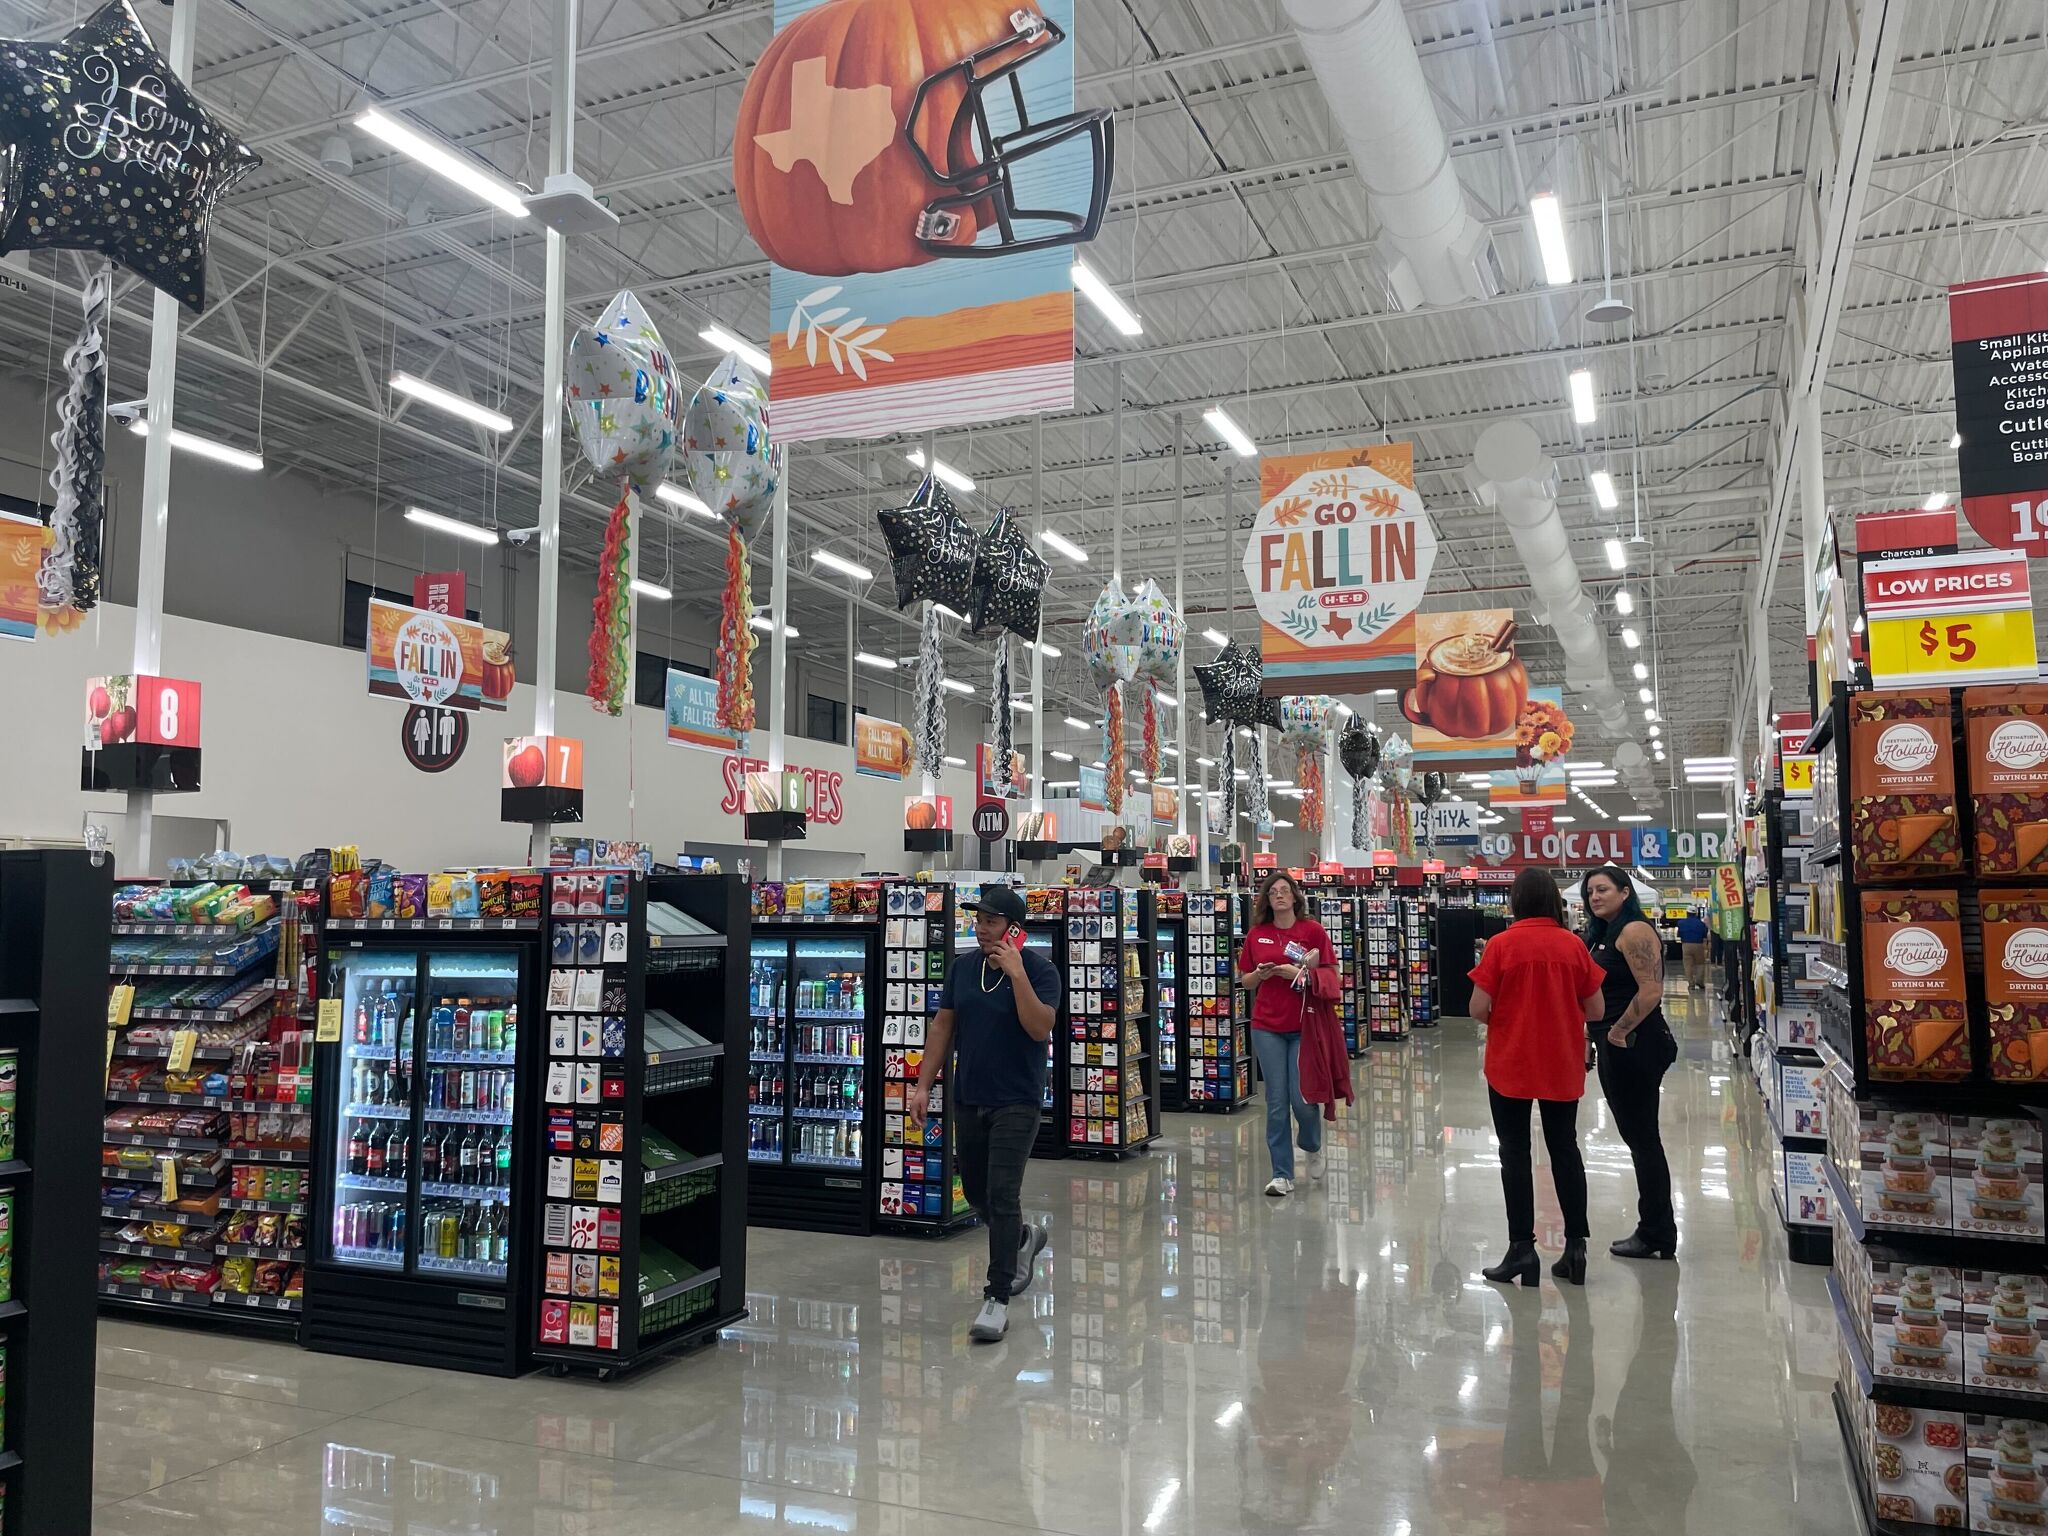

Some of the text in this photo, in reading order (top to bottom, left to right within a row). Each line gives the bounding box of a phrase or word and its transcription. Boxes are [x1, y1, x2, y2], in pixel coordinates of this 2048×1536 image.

[1979, 332, 2048, 350] Small Kit
[1314, 501, 1357, 526] GO
[1260, 521, 1416, 593] FALL IN
[1880, 547, 1934, 559] Charcoal &
[1877, 572, 2013, 596] LOW PRICES
[421, 632, 437, 645] GO
[400, 640, 457, 680] FALL IN
[688, 687, 718, 709] ALL TH
[160, 688, 178, 740] 8
[683, 705, 701, 726] FALL
[1789, 740, 1806, 749] LO
[1878, 742, 1938, 761] Holiday
[560, 745, 570, 784] 7
[1881, 775, 1913, 784] DRYING
[789, 778, 798, 810] 6
[941, 800, 947, 827] 5
[979, 812, 1003, 832] ATM
[1481, 835, 1510, 855] GO
[1524, 833, 1624, 859] LOCAL
[1641, 833, 1662, 859] &
[1257, 869, 1268, 877] 10
[1378, 867, 1389, 875] 10
[524, 887, 540, 898] TIME
[1720, 867, 1741, 907] SAVE!
[1888, 947, 1947, 965] Holiday
